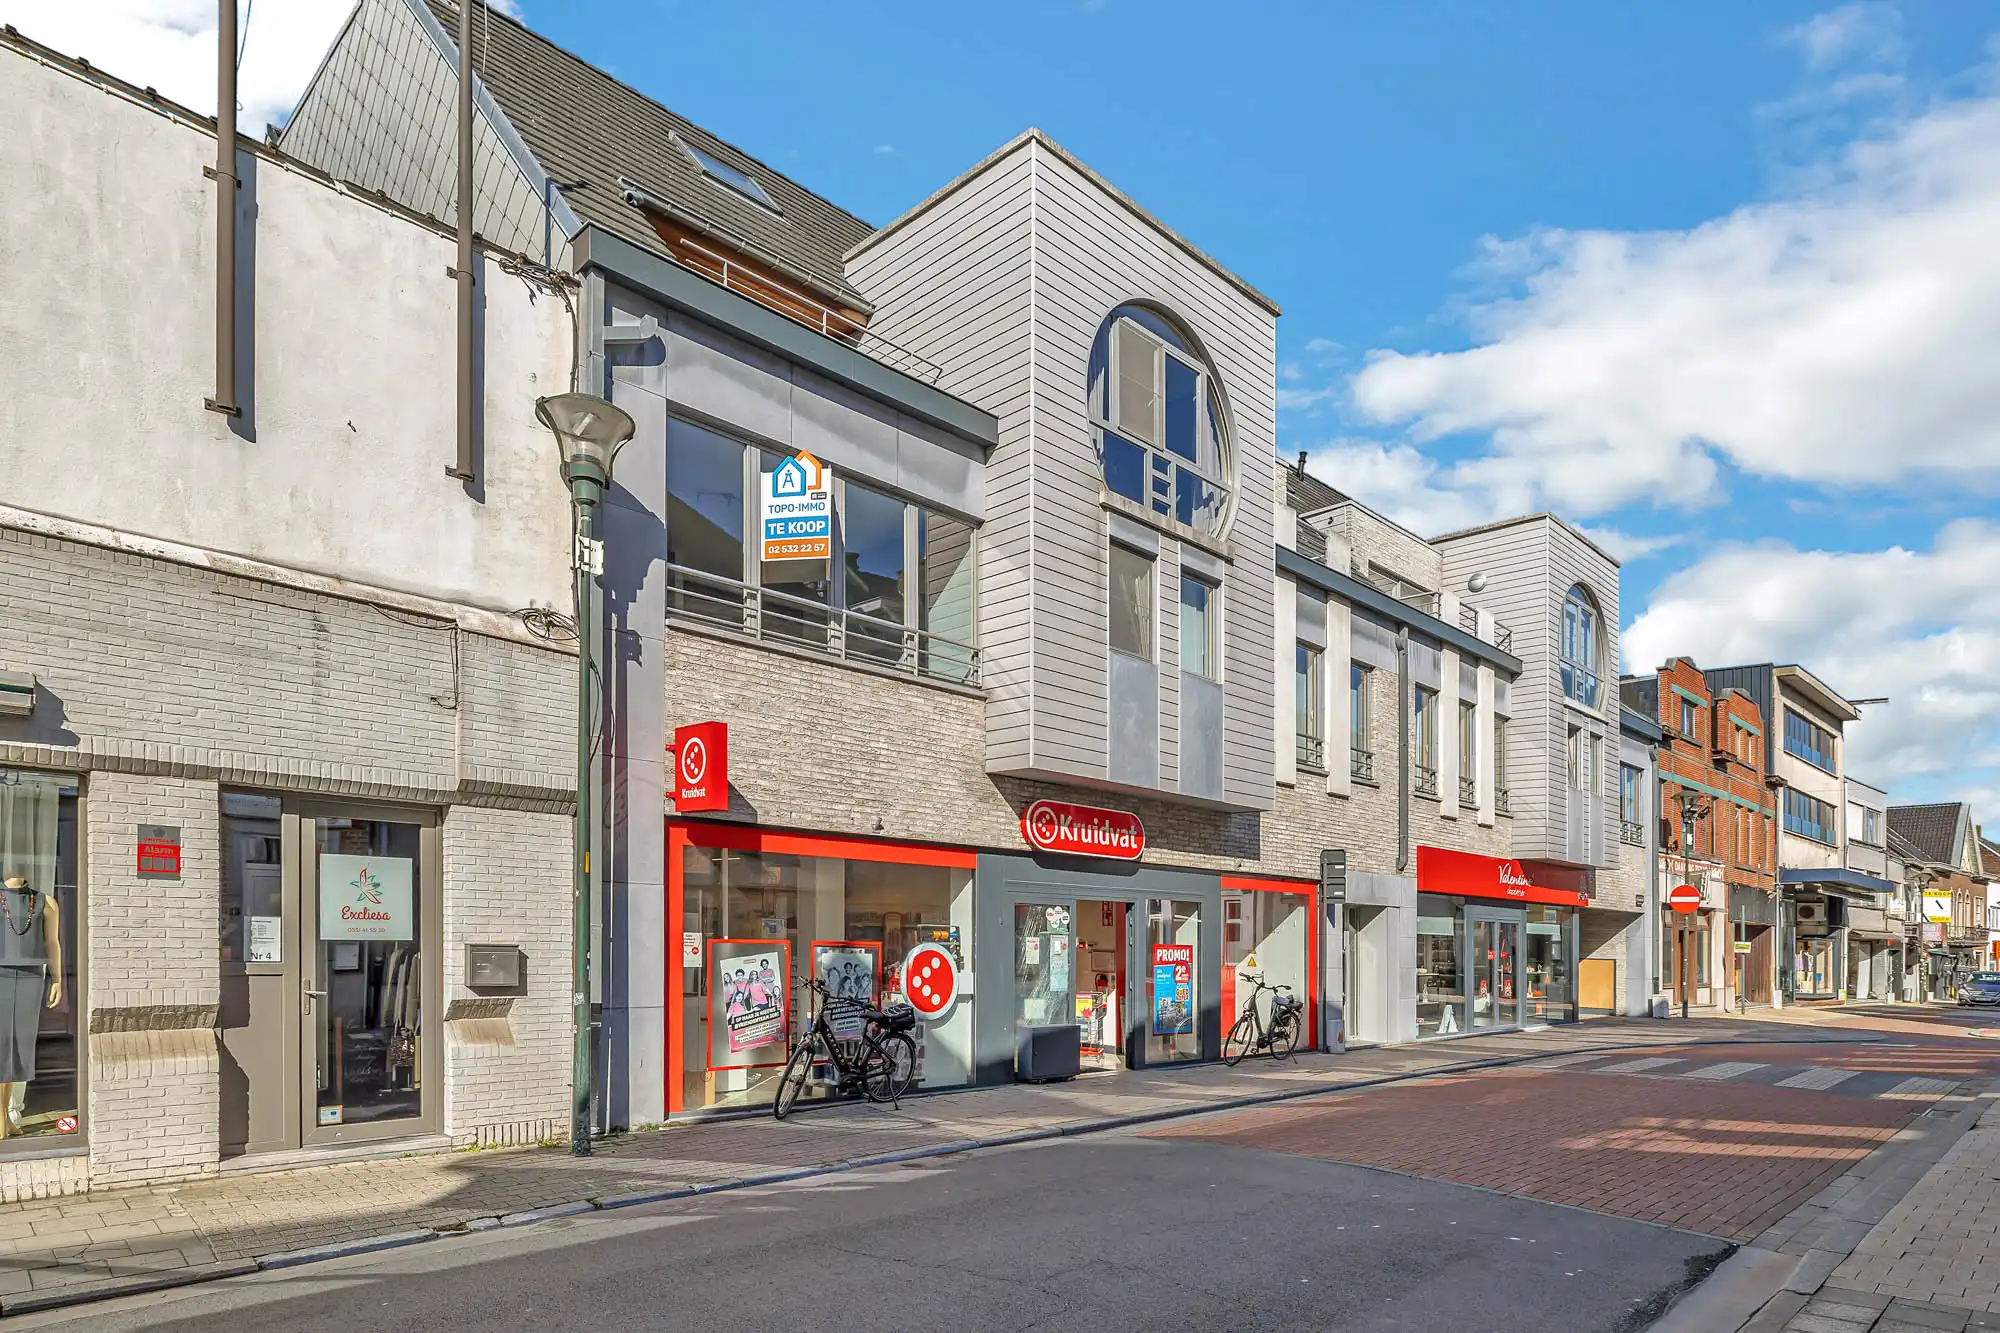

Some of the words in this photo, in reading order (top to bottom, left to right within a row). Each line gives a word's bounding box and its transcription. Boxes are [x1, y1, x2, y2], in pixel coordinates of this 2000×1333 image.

[768, 502, 825, 514] TOPO-IMMO
[768, 522, 785, 535] TE
[788, 520, 826, 534] KOOP
[768, 546, 780, 554] 02
[781, 544, 799, 553] 532
[801, 543, 812, 552] 22
[814, 543, 825, 552] 57
[682, 787, 706, 799] Kruidvat
[1060, 813, 1137, 849] Kruidvat
[144, 845, 174, 855] Alarm
[341, 905, 391, 921] Excliesa
[250, 952, 263, 960] Nr
[265, 952, 272, 960] 4
[1156, 948, 1190, 962] PROMO!
